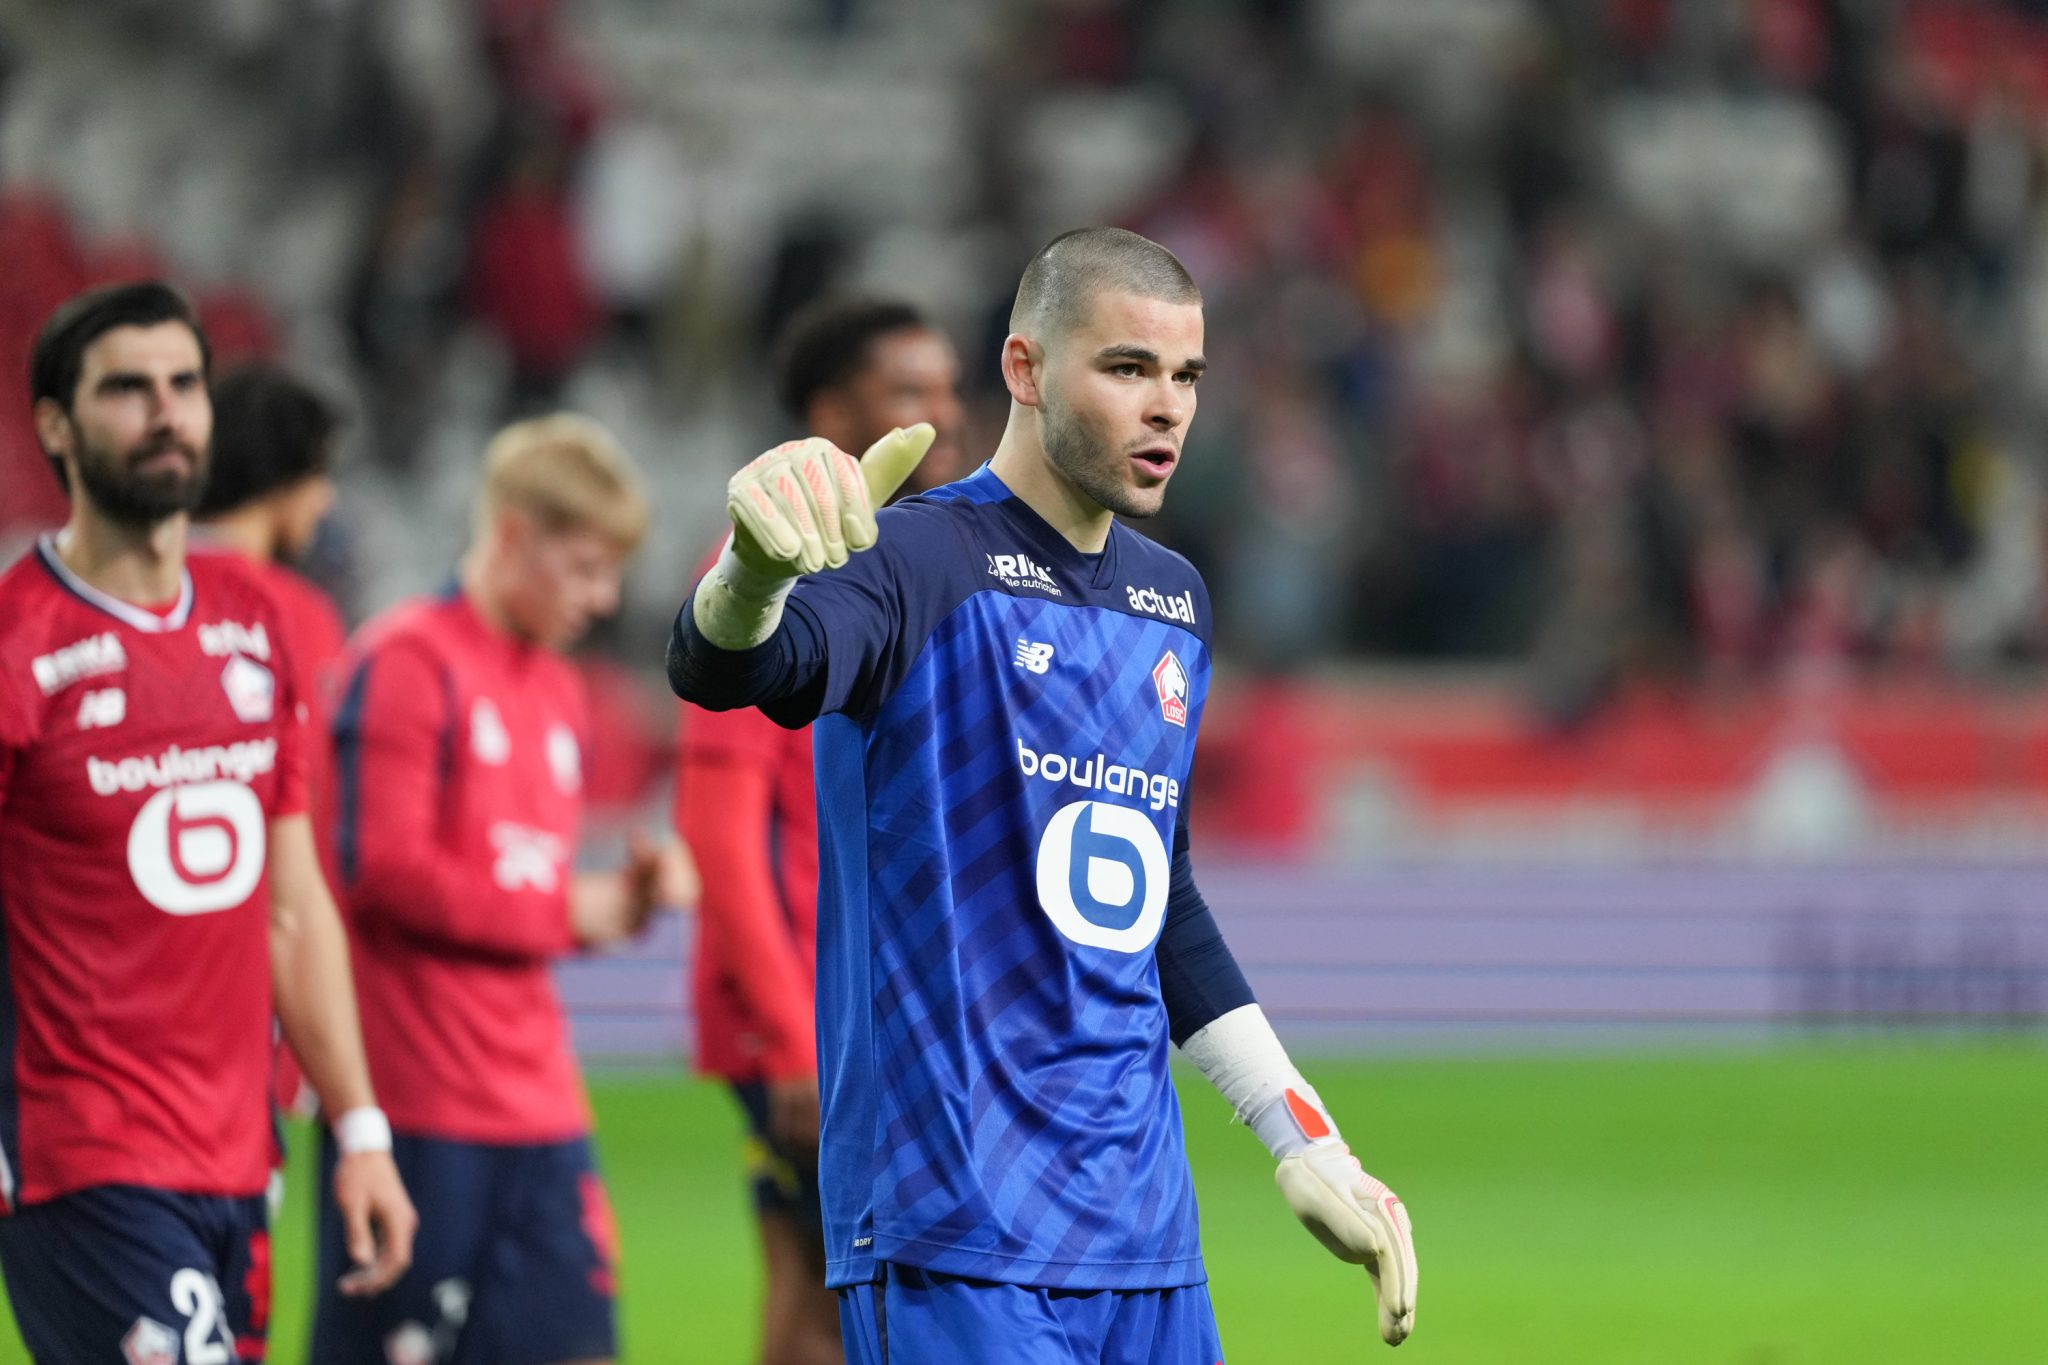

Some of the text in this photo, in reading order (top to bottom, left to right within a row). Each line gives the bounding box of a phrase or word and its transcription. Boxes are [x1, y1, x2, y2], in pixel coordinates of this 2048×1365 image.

[1022, 579, 1062, 597] autrichien
[1126, 585, 1196, 625] actual
[1165, 703, 1184, 721] LOSC
